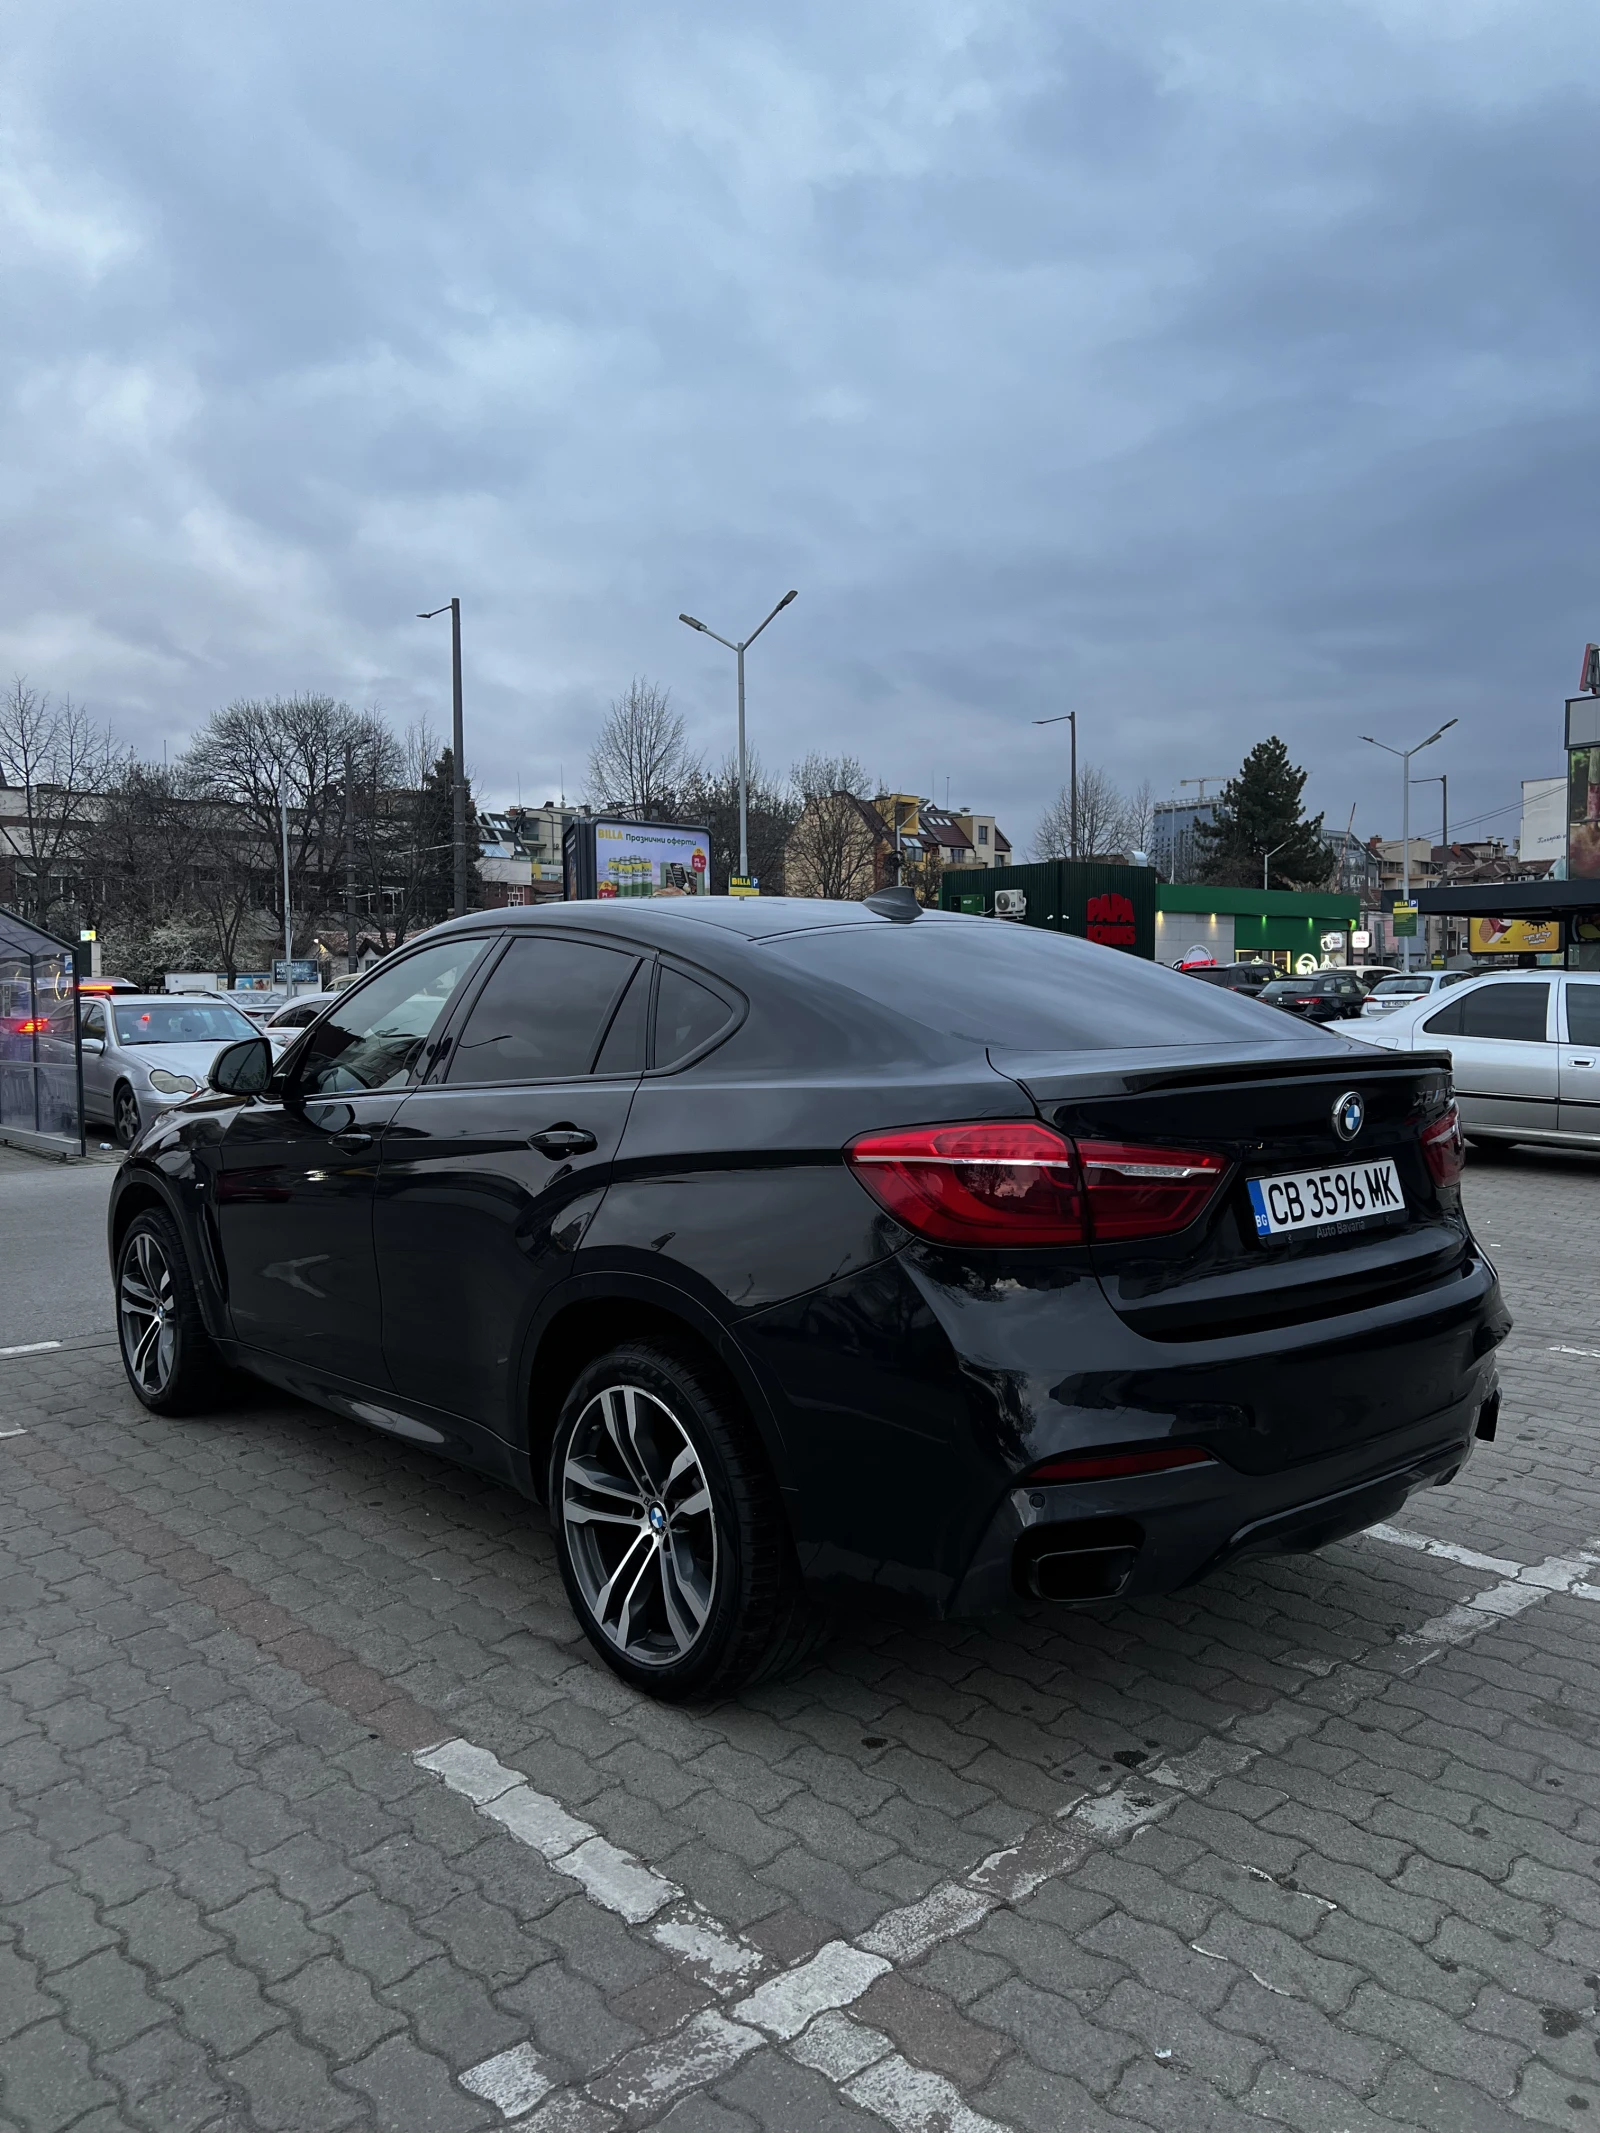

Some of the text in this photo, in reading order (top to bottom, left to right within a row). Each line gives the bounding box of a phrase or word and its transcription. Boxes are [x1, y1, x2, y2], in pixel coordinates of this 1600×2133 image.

[597, 828, 623, 840] BILLA
[625, 833, 697, 847] Празнични оферти
[731, 877, 751, 886] BILLA
[1087, 893, 1135, 923] PAPA
[1267, 1166, 1400, 1226] CB 3596 MK
[1255, 1214, 1268, 1228] BG
[1316, 1218, 1366, 1239] Auto Bavaria
